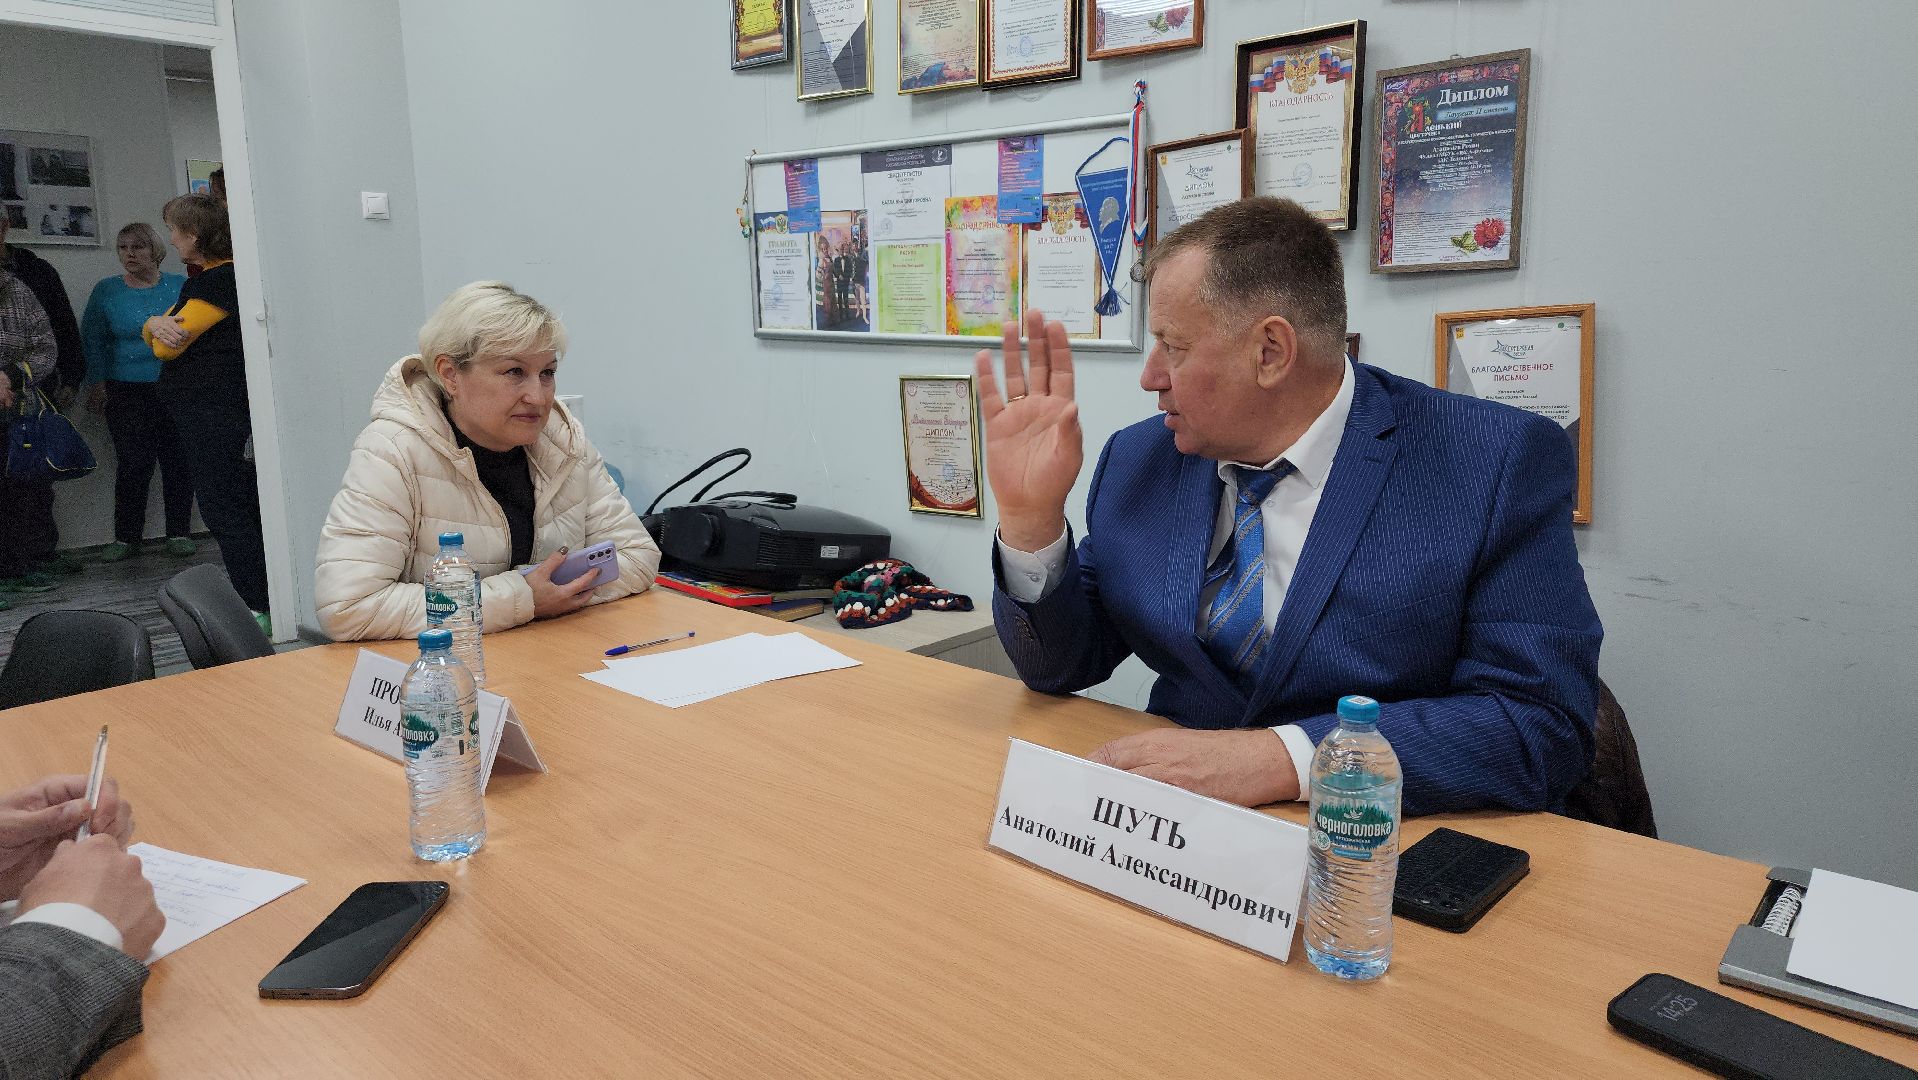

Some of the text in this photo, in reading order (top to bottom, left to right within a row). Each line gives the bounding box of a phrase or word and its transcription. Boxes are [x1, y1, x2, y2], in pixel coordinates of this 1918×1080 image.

[1269, 93, 1334, 108] БЛАГОДАРНОСТЬ
[1437, 85, 1509, 108] Диплом
[1471, 363, 1554, 374] БЛАГОДАРСТВЕННОЕ
[1494, 374, 1529, 382] ПИСЬМО
[925, 428, 955, 437] ДИПЛОМ
[369, 677, 400, 705] ПРО
[363, 706, 392, 732] Илья
[1092, 796, 1187, 851] ШУТЬ
[1317, 813, 1392, 837] черноголовка
[998, 805, 1292, 930] Анатолий Александрович
